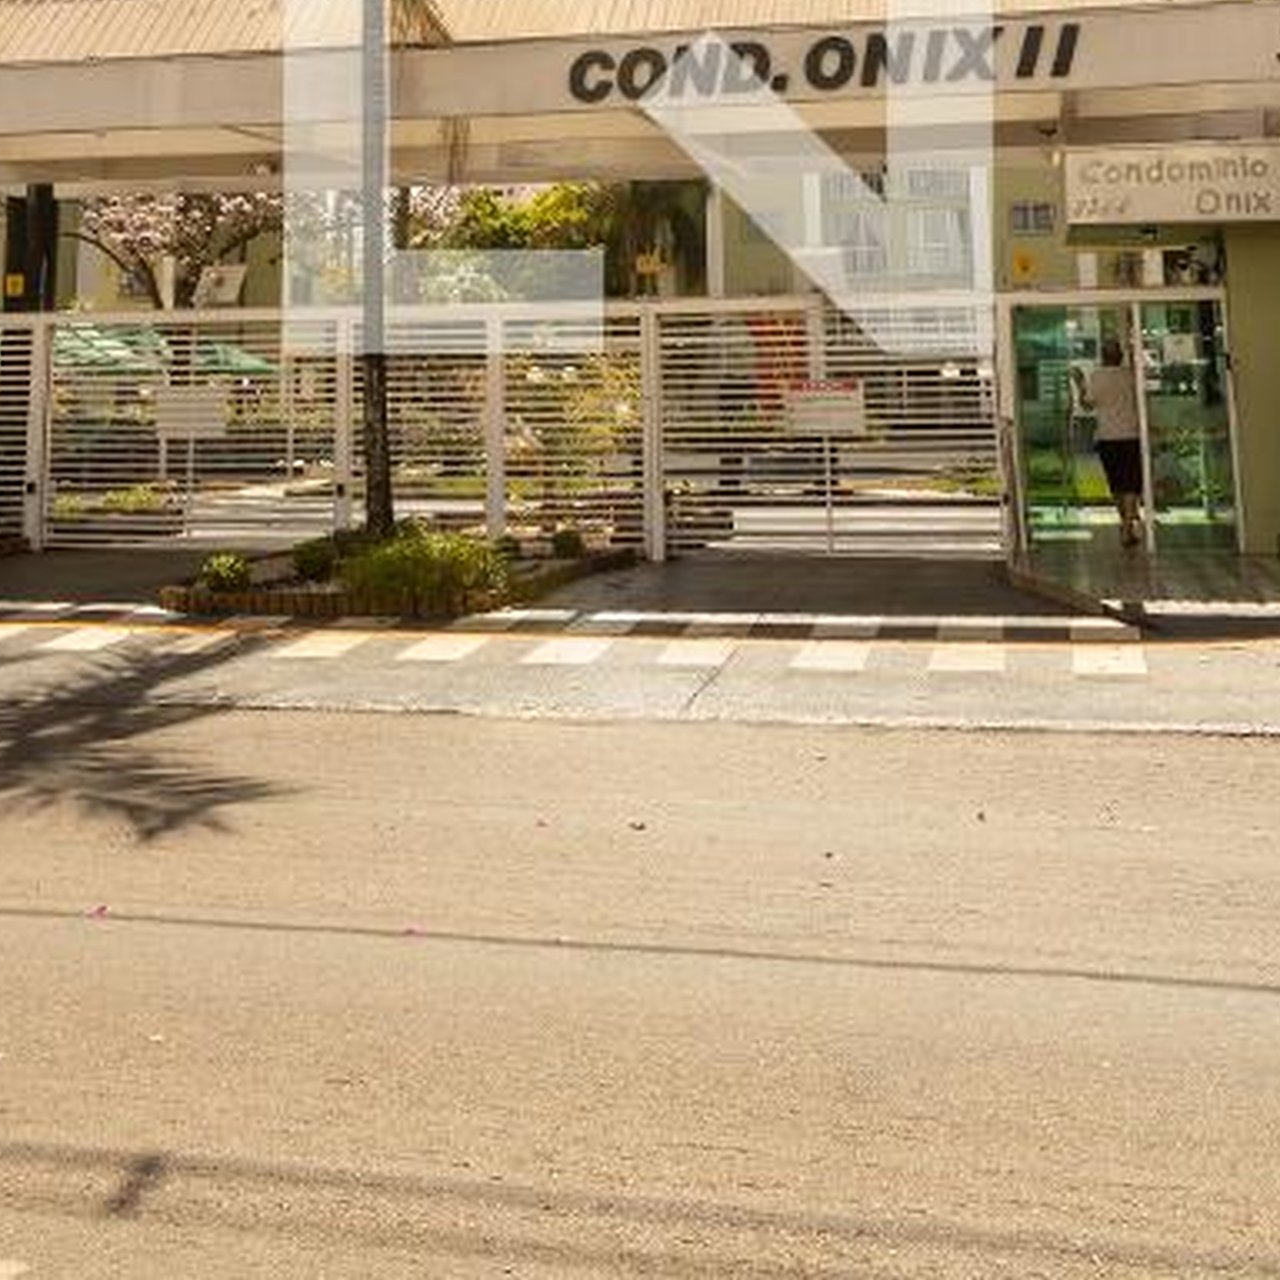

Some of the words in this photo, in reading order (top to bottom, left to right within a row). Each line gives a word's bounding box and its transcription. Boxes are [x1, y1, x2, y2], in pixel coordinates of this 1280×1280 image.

[569, 41, 787, 102] COND.
[804, 26, 1005, 89] ONIX
[1015, 23, 1080, 78] II
[1195, 188, 1273, 215] Onix
